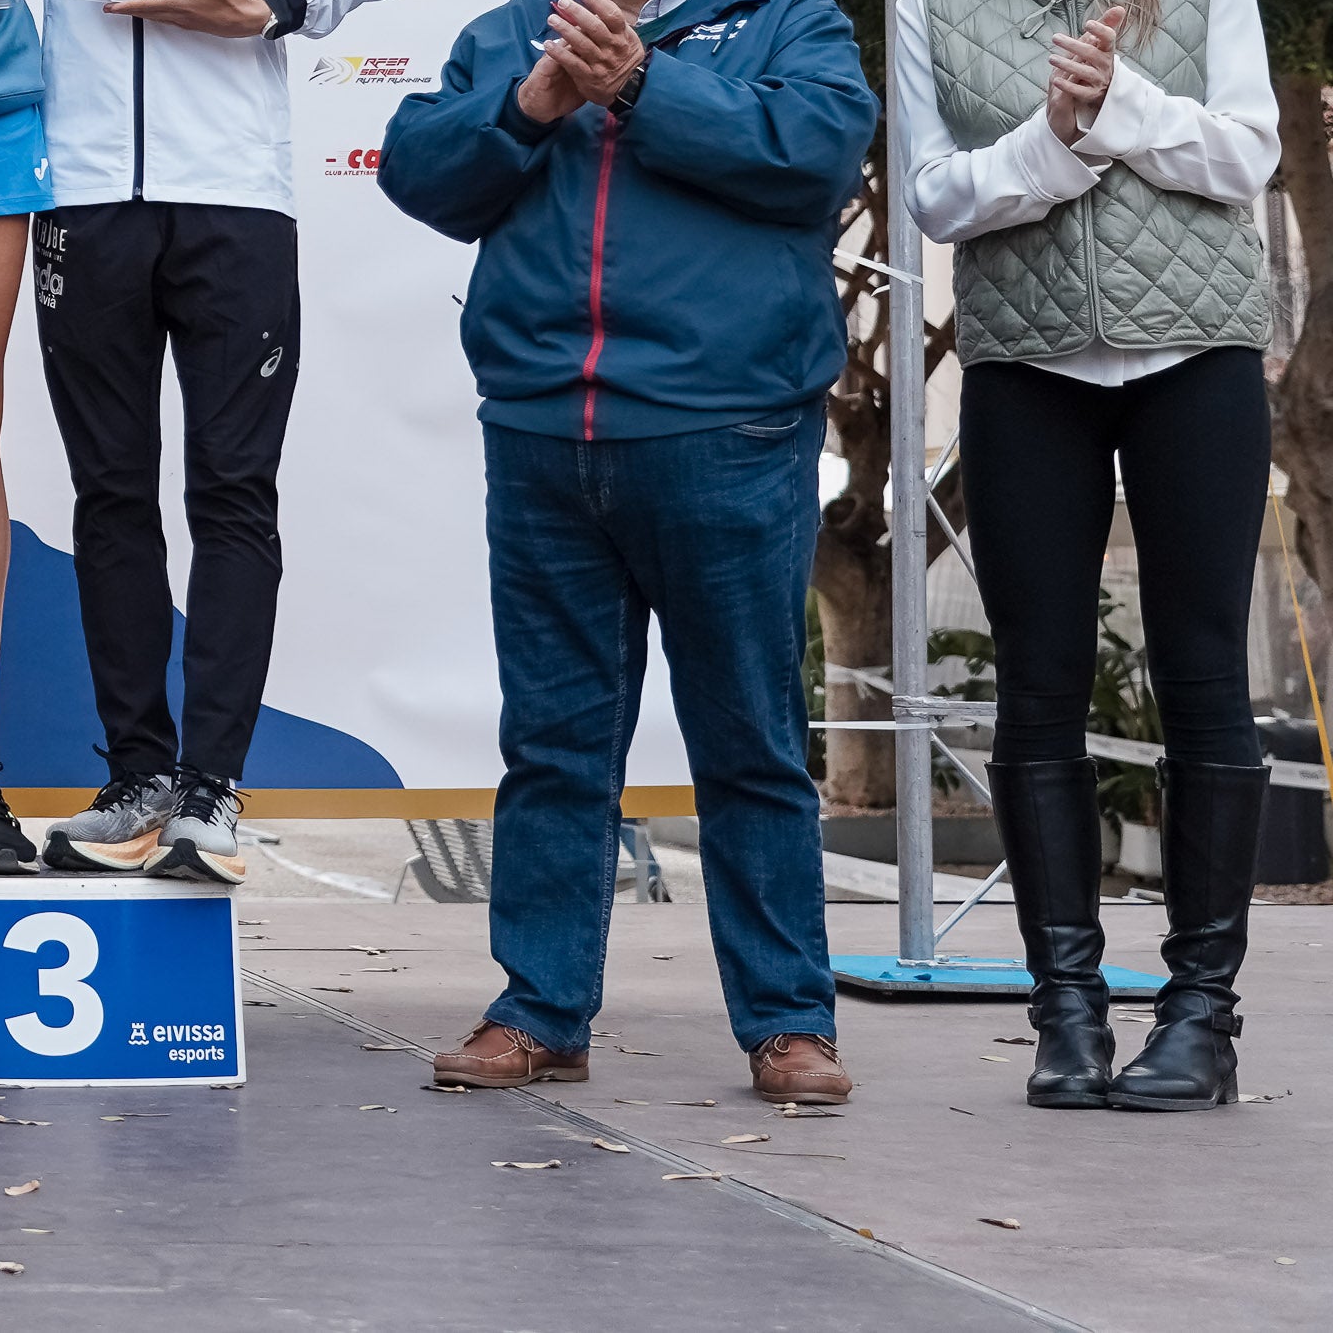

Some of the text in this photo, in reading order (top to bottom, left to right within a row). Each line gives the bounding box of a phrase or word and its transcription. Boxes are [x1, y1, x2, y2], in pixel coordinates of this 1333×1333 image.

[364, 57, 410, 69] RFEA
[355, 77, 433, 86] RUTA RUNNING
[359, 68, 406, 78] SERIES
[347, 148, 382, 169] ca
[2, 911, 104, 1057] 3
[152, 1024, 225, 1043] eivissa
[168, 1045, 225, 1064] esports
